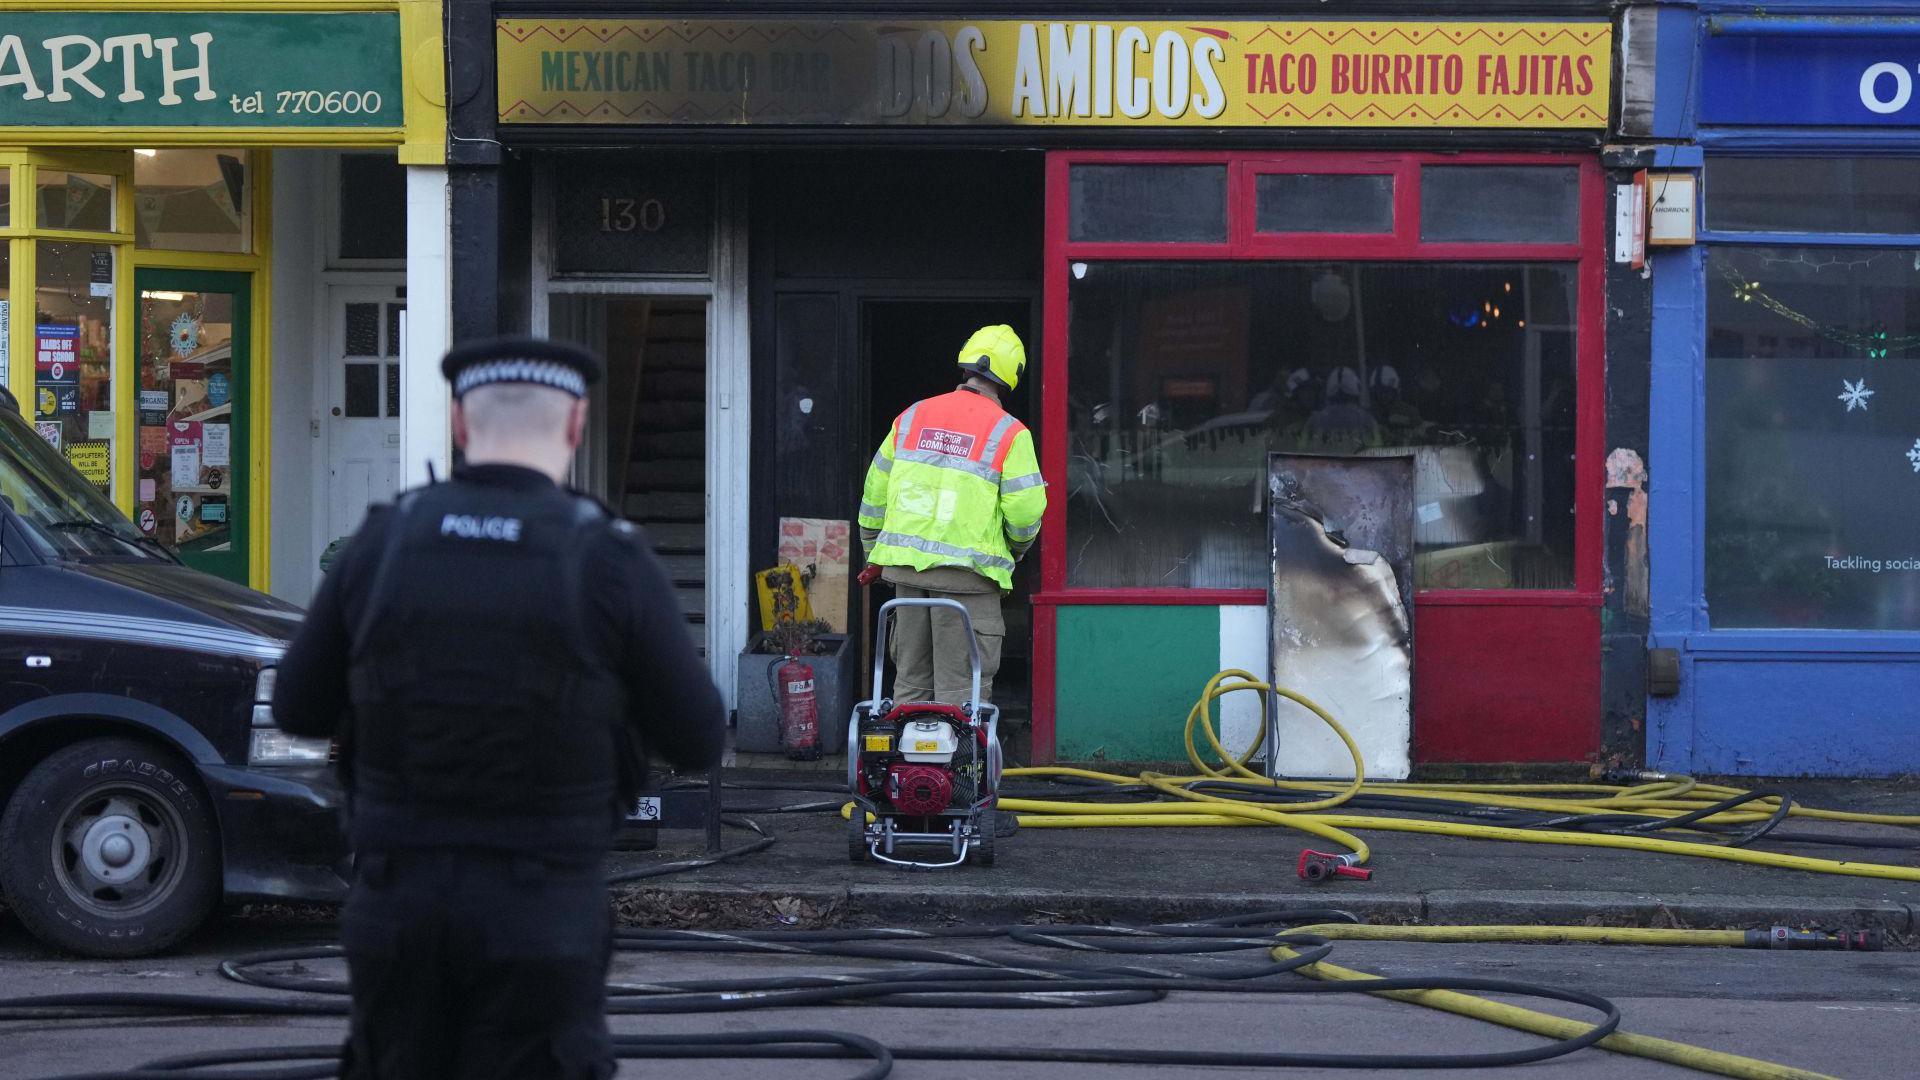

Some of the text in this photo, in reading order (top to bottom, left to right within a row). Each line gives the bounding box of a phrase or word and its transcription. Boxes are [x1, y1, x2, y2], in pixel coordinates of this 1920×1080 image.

[541, 50, 833, 94] MEXICAN TACO BAR
[875, 22, 1226, 119] DOS AMIGOS
[1245, 53, 1594, 96] TACO BURRITO FAJITAS
[1859, 62, 1920, 114] O
[229, 90, 382, 115] tel 770600
[600, 198, 665, 231] 130
[40, 338, 73, 350] HANDS OFF
[920, 439, 969, 456] COMMANDER
[934, 431, 962, 445] SECTOR
[71, 452, 104, 460] SHOPLIFTERS
[441, 514, 522, 543] POLICE
[1824, 556, 1881, 573] Tackling
